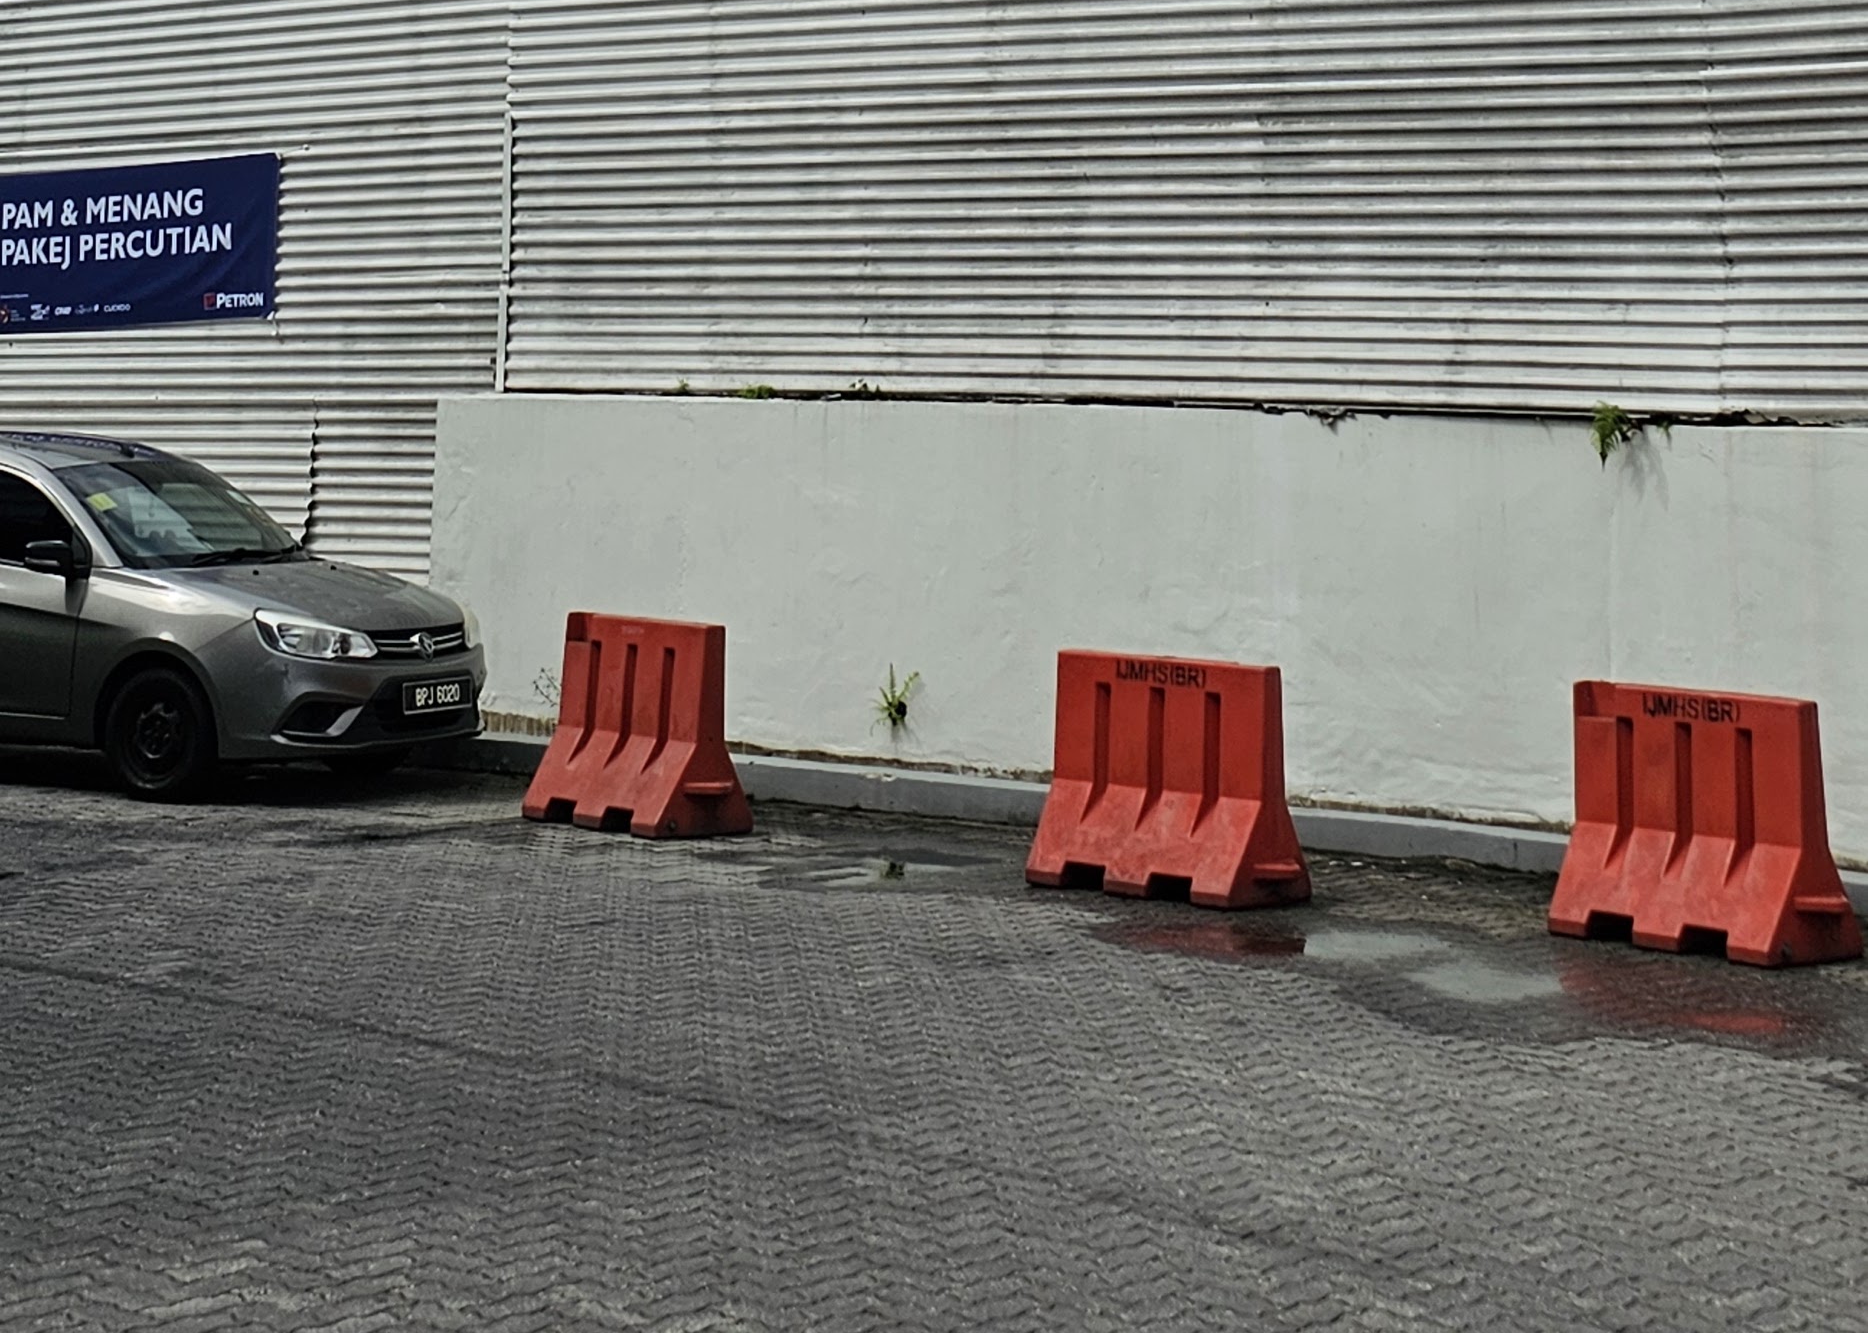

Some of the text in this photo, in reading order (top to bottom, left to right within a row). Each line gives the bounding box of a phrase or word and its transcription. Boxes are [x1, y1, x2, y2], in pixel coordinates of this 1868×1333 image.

[2, 188, 203, 230] PAM & MENANG
[1, 223, 232, 270] PAKEJ PERCUTIAN
[216, 292, 264, 309] PETRON
[415, 686, 434, 707] BPJ
